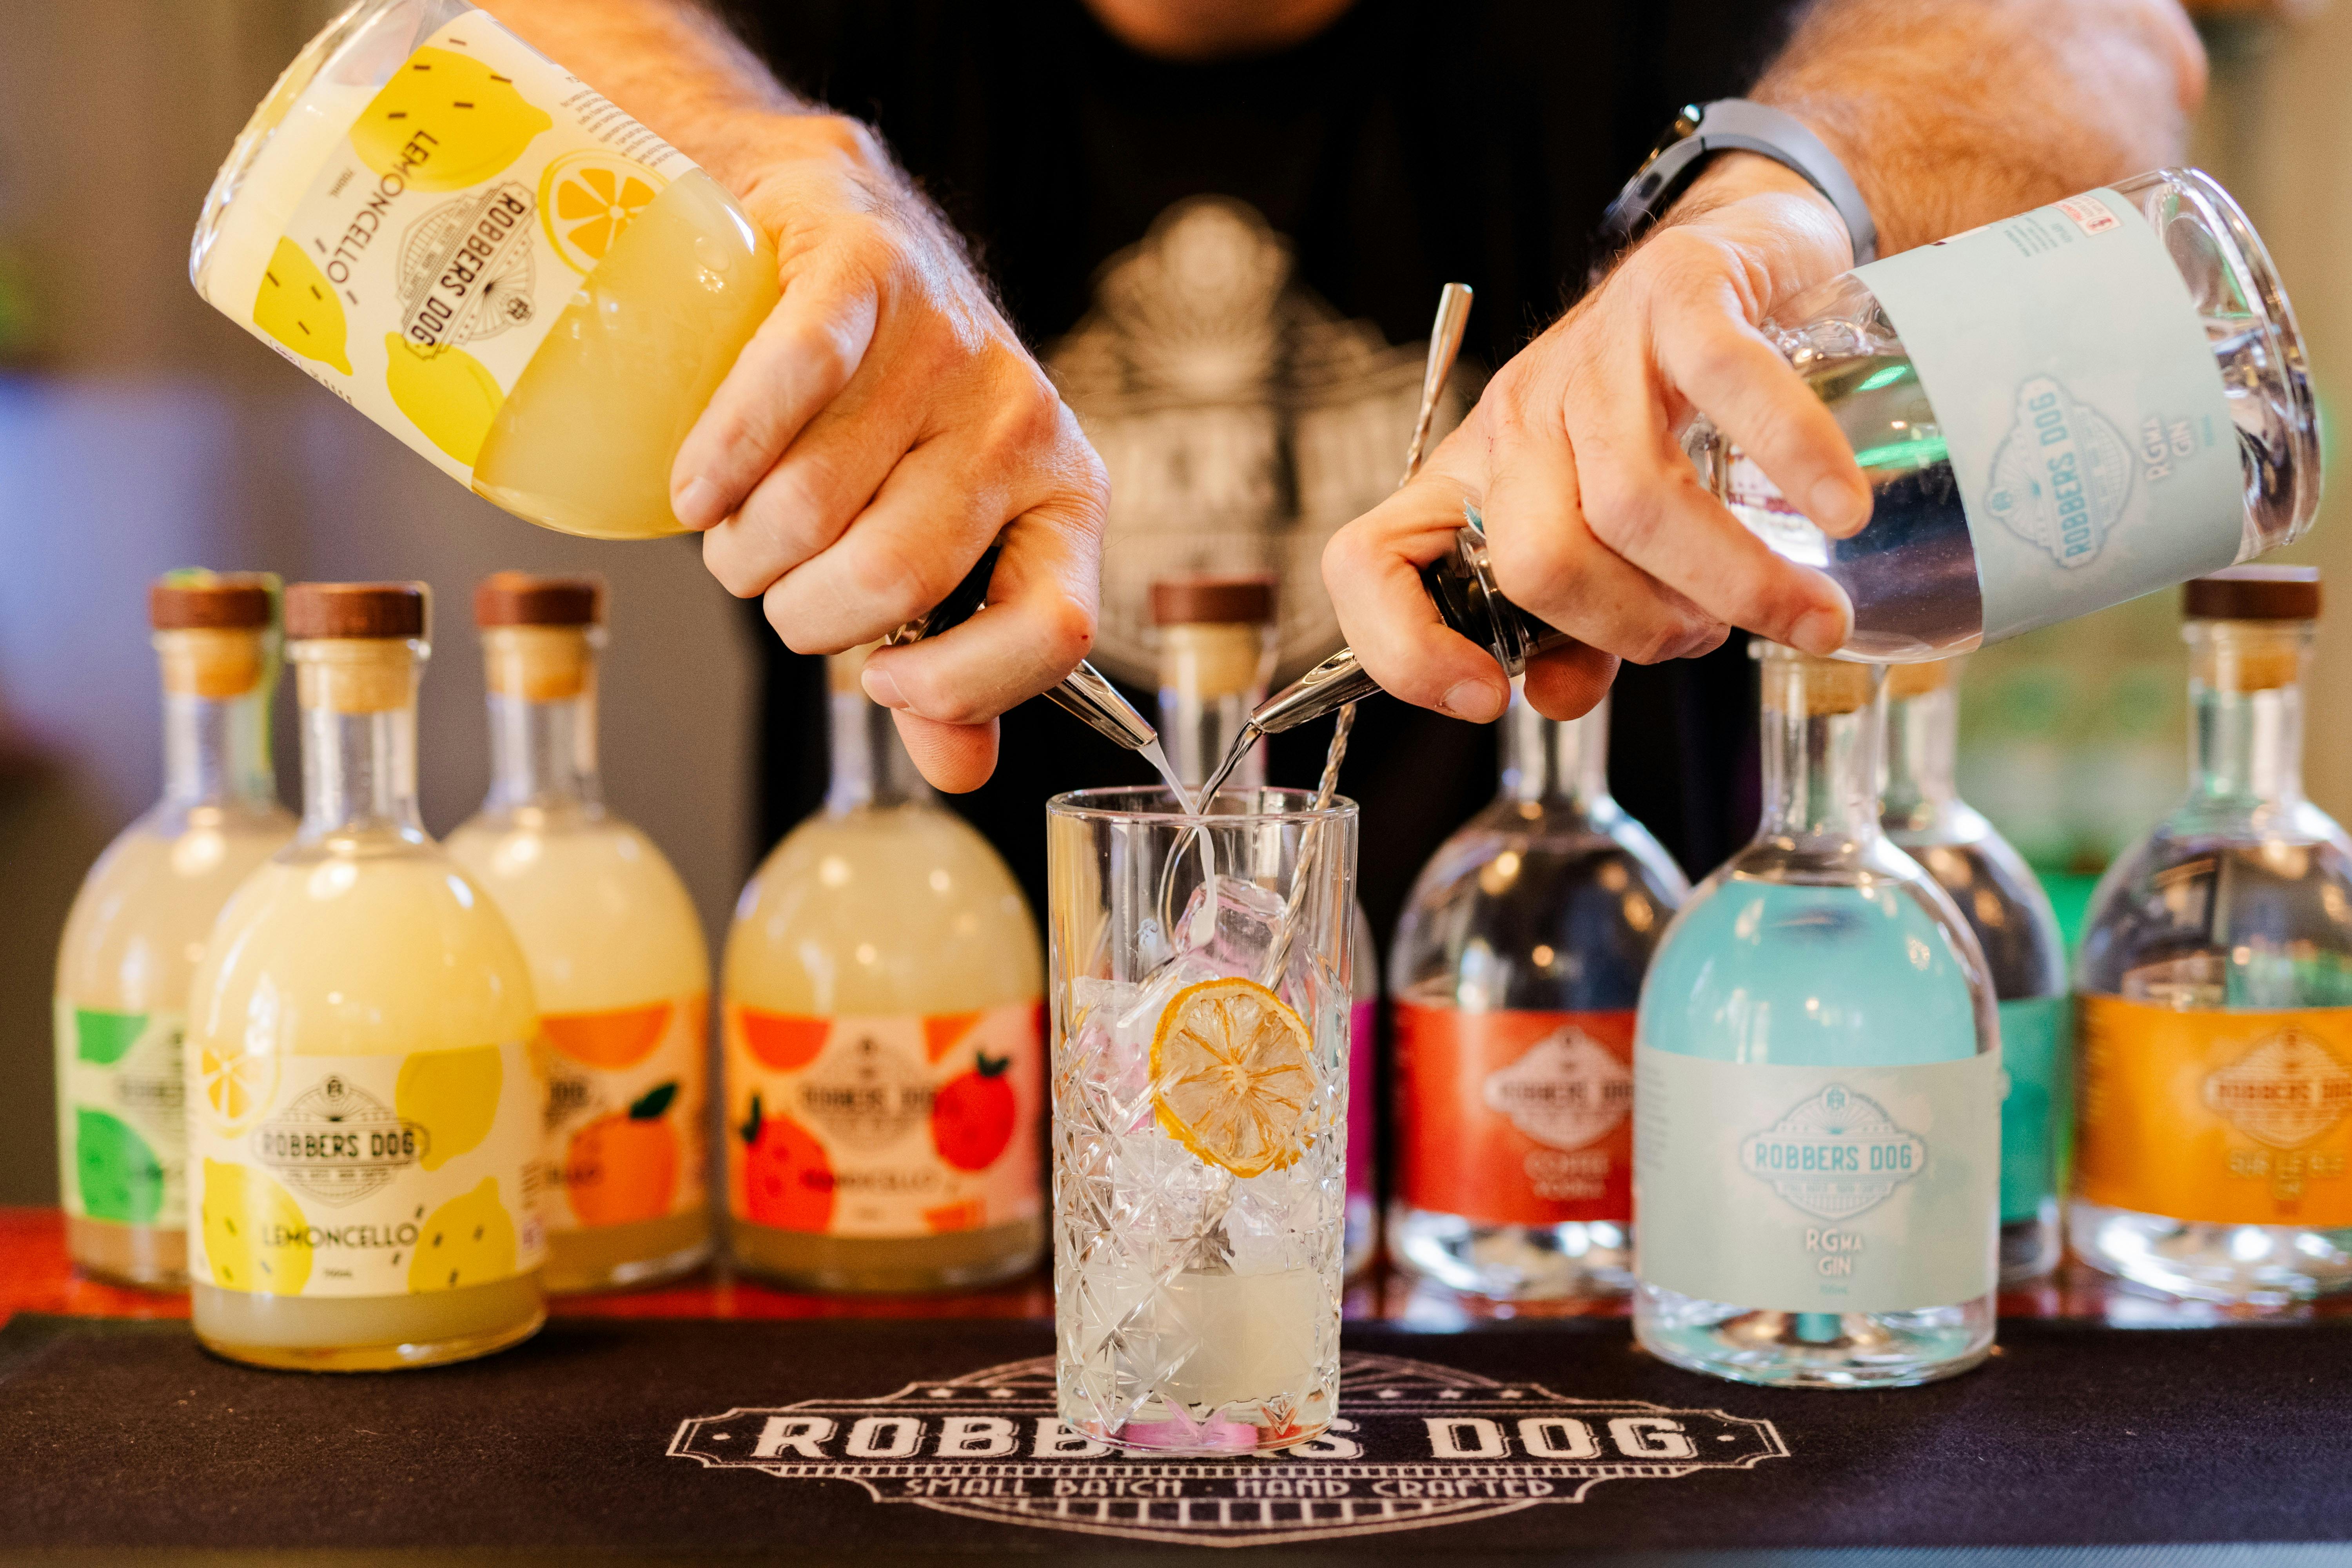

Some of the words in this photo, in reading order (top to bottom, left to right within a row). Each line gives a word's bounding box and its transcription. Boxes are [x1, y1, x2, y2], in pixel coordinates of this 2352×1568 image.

[327, 129, 439, 283] LEMONCELLO
[440, 192, 525, 297] ROBBERS
[410, 295, 452, 347] DOG
[2028, 392, 2068, 447] DOG
[2169, 419, 2193, 457] GIN
[2047, 451, 2092, 558] ROBBERS
[263, 1133, 358, 1158] ROBBERS
[371, 1129, 415, 1157] DOG
[1755, 1143, 1859, 1171] ROBBERS
[1870, 1144, 1912, 1171] DOG
[263, 1222, 418, 1248] LEMONCELLO
[1819, 1256, 1852, 1276] GIN
[750, 1416, 1365, 1459] ROBBS
[1425, 1417, 1699, 1459] DOG
[905, 1478, 1032, 1497] SMALL
[1053, 1478, 1183, 1497] BATCH
[1236, 1478, 1350, 1498] HAND
[1372, 1478, 1555, 1498] CRAFTED
